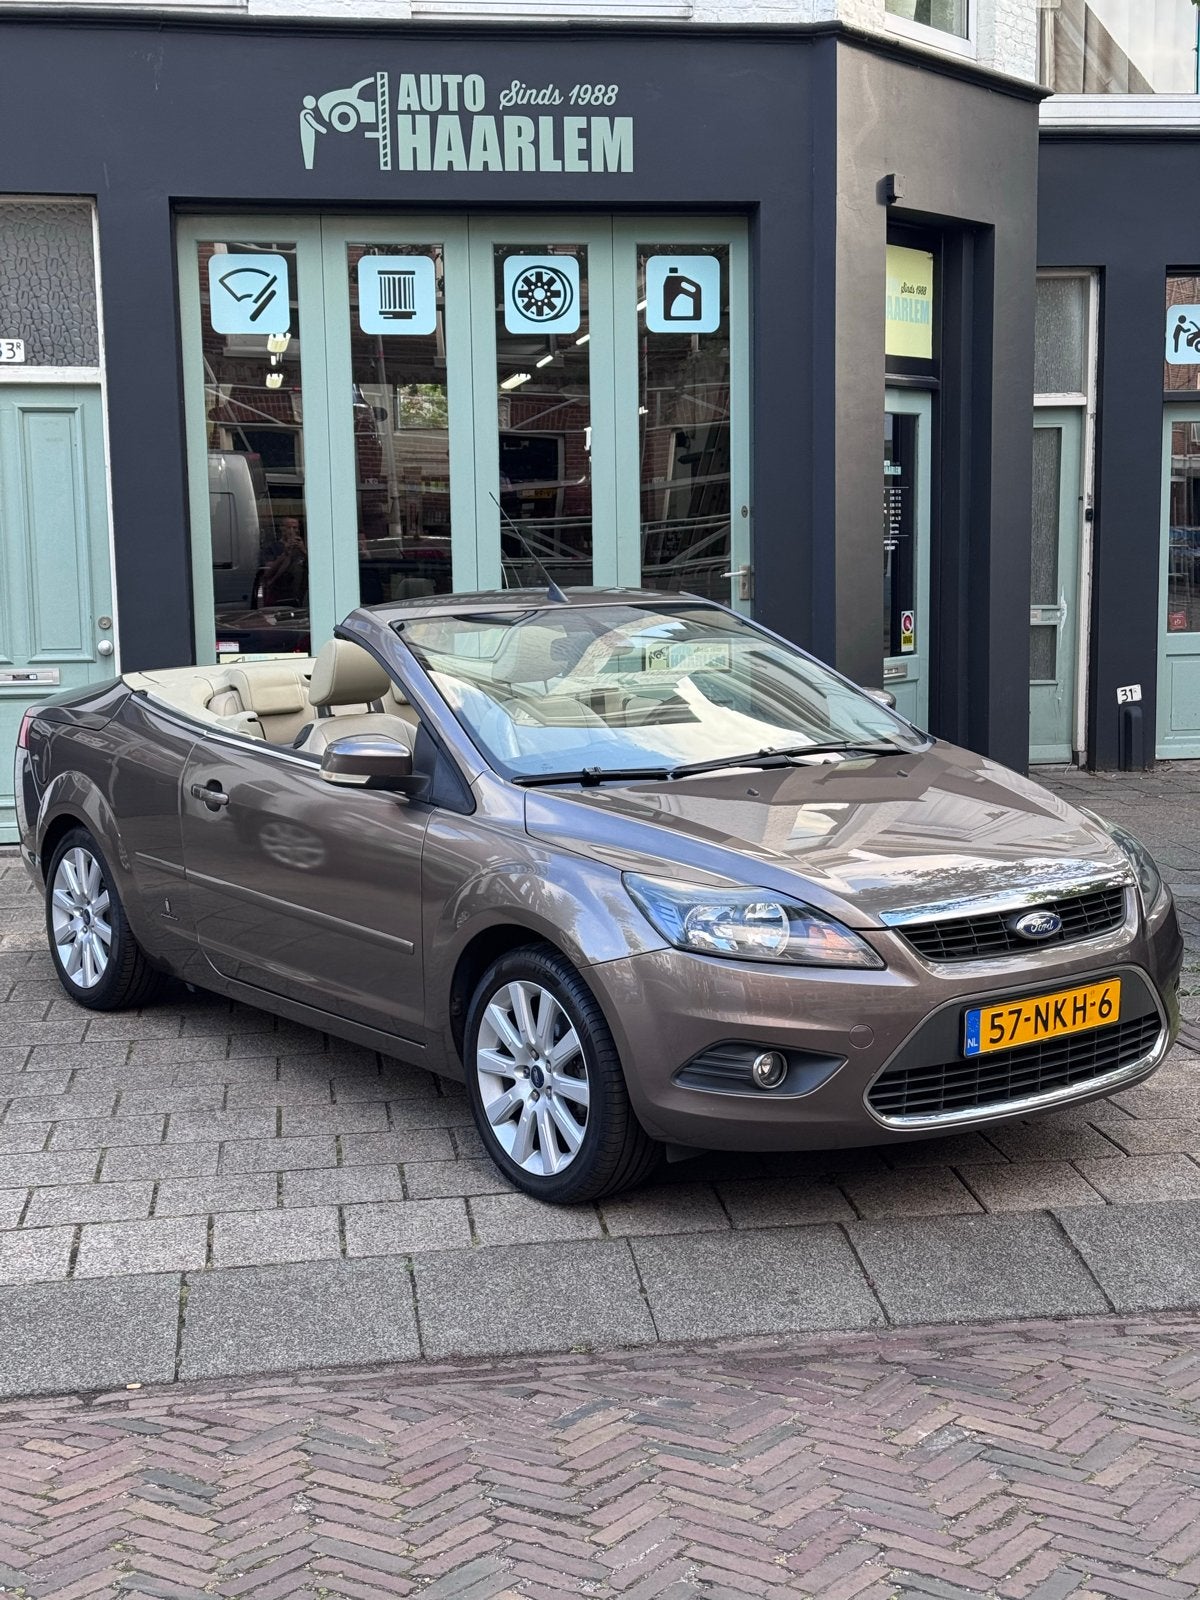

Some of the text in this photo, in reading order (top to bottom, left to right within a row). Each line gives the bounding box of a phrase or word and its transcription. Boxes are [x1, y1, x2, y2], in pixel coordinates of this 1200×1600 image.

[398, 74, 619, 112] AUTO Sinds 1988
[398, 115, 634, 173] HAARLEM
[0, 342, 21, 360] 3R
[1030, 917, 1054, 932] Ford
[989, 988, 1113, 1044] 57-NKH-6
[967, 1038, 978, 1048] NL
